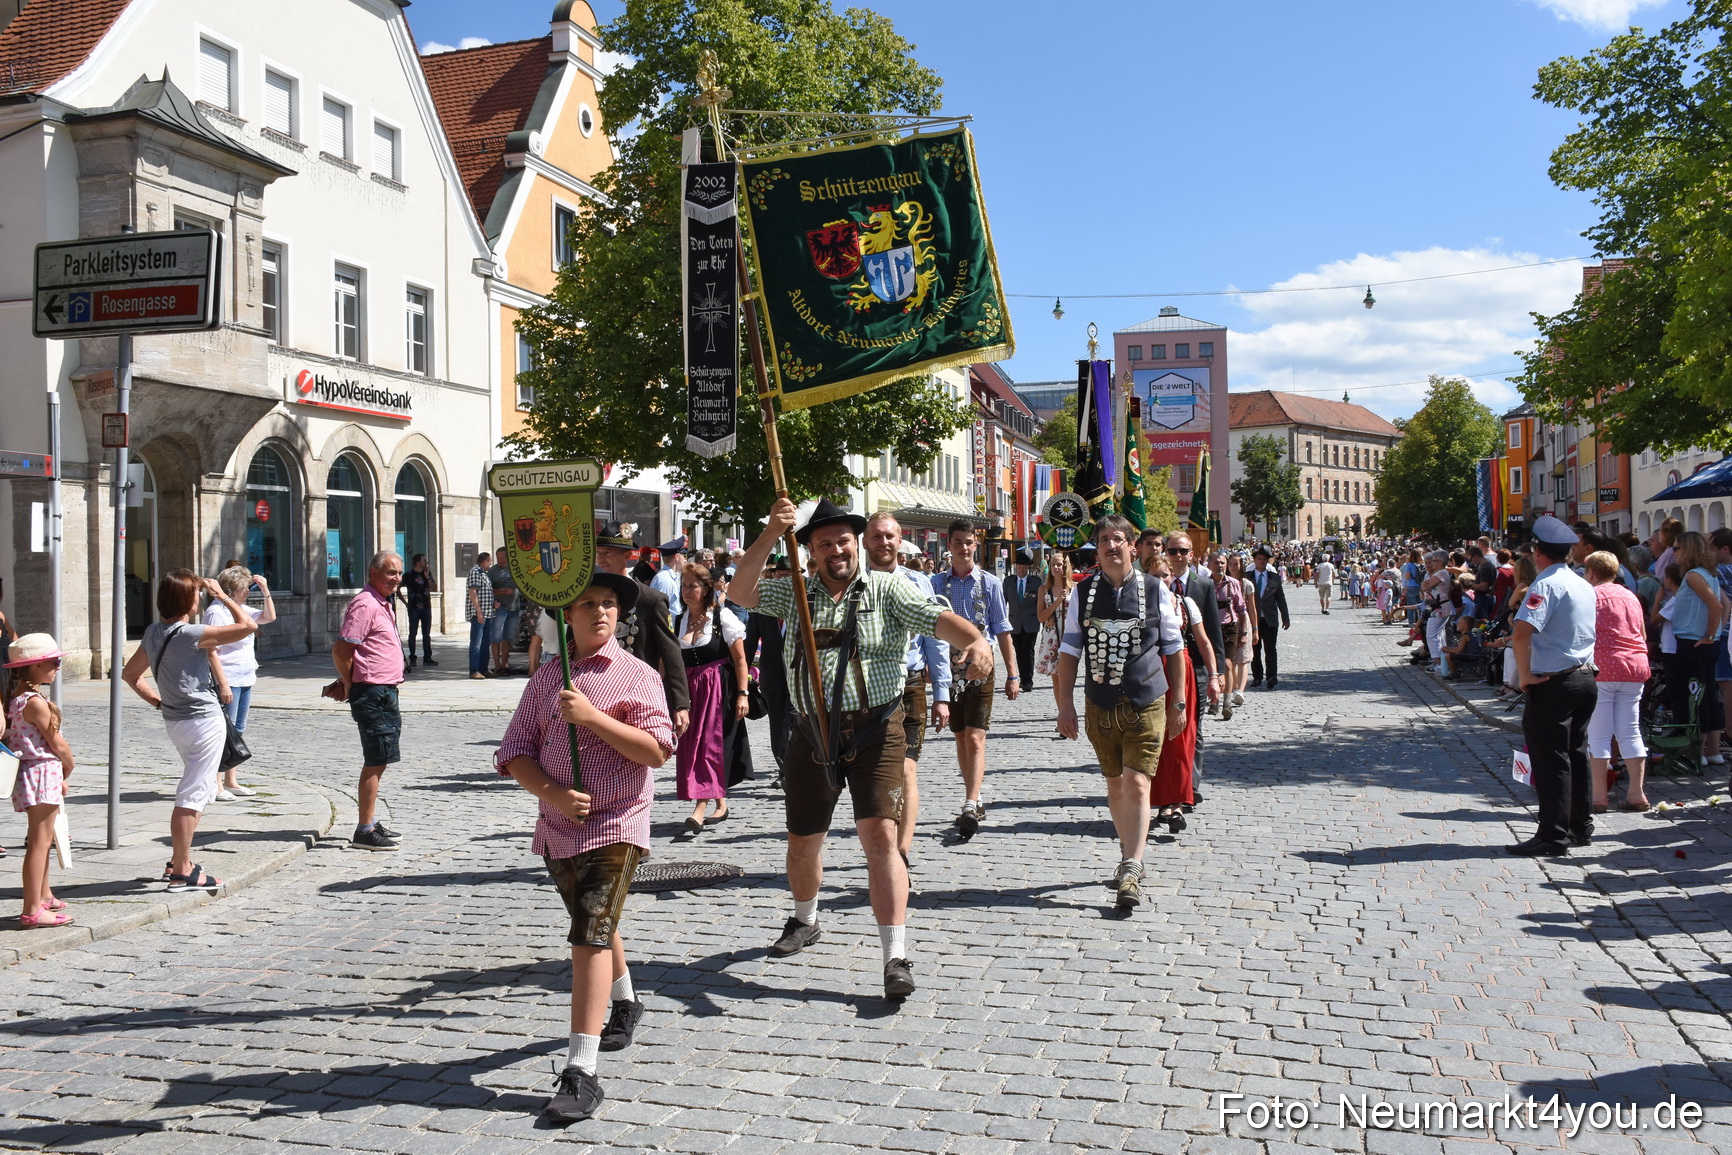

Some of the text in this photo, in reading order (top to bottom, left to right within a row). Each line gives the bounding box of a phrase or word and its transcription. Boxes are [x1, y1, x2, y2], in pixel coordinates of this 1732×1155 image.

[694, 176, 726, 188] 2002
[799, 170, 922, 203] Schützengau
[690, 234, 733, 251] Den Toten
[64, 248, 177, 277] Parkleitsystem
[697, 259, 709, 275] zur
[102, 295, 176, 316] Rosengasse
[689, 365, 732, 379] Schützengau
[88, 377, 117, 394] Rosengass
[315, 373, 412, 410] HypoVereinsbank
[696, 380, 726, 394] Altdorf
[693, 396, 728, 408] Neumarkt
[499, 469, 590, 487] SCHÜTZENGAU
